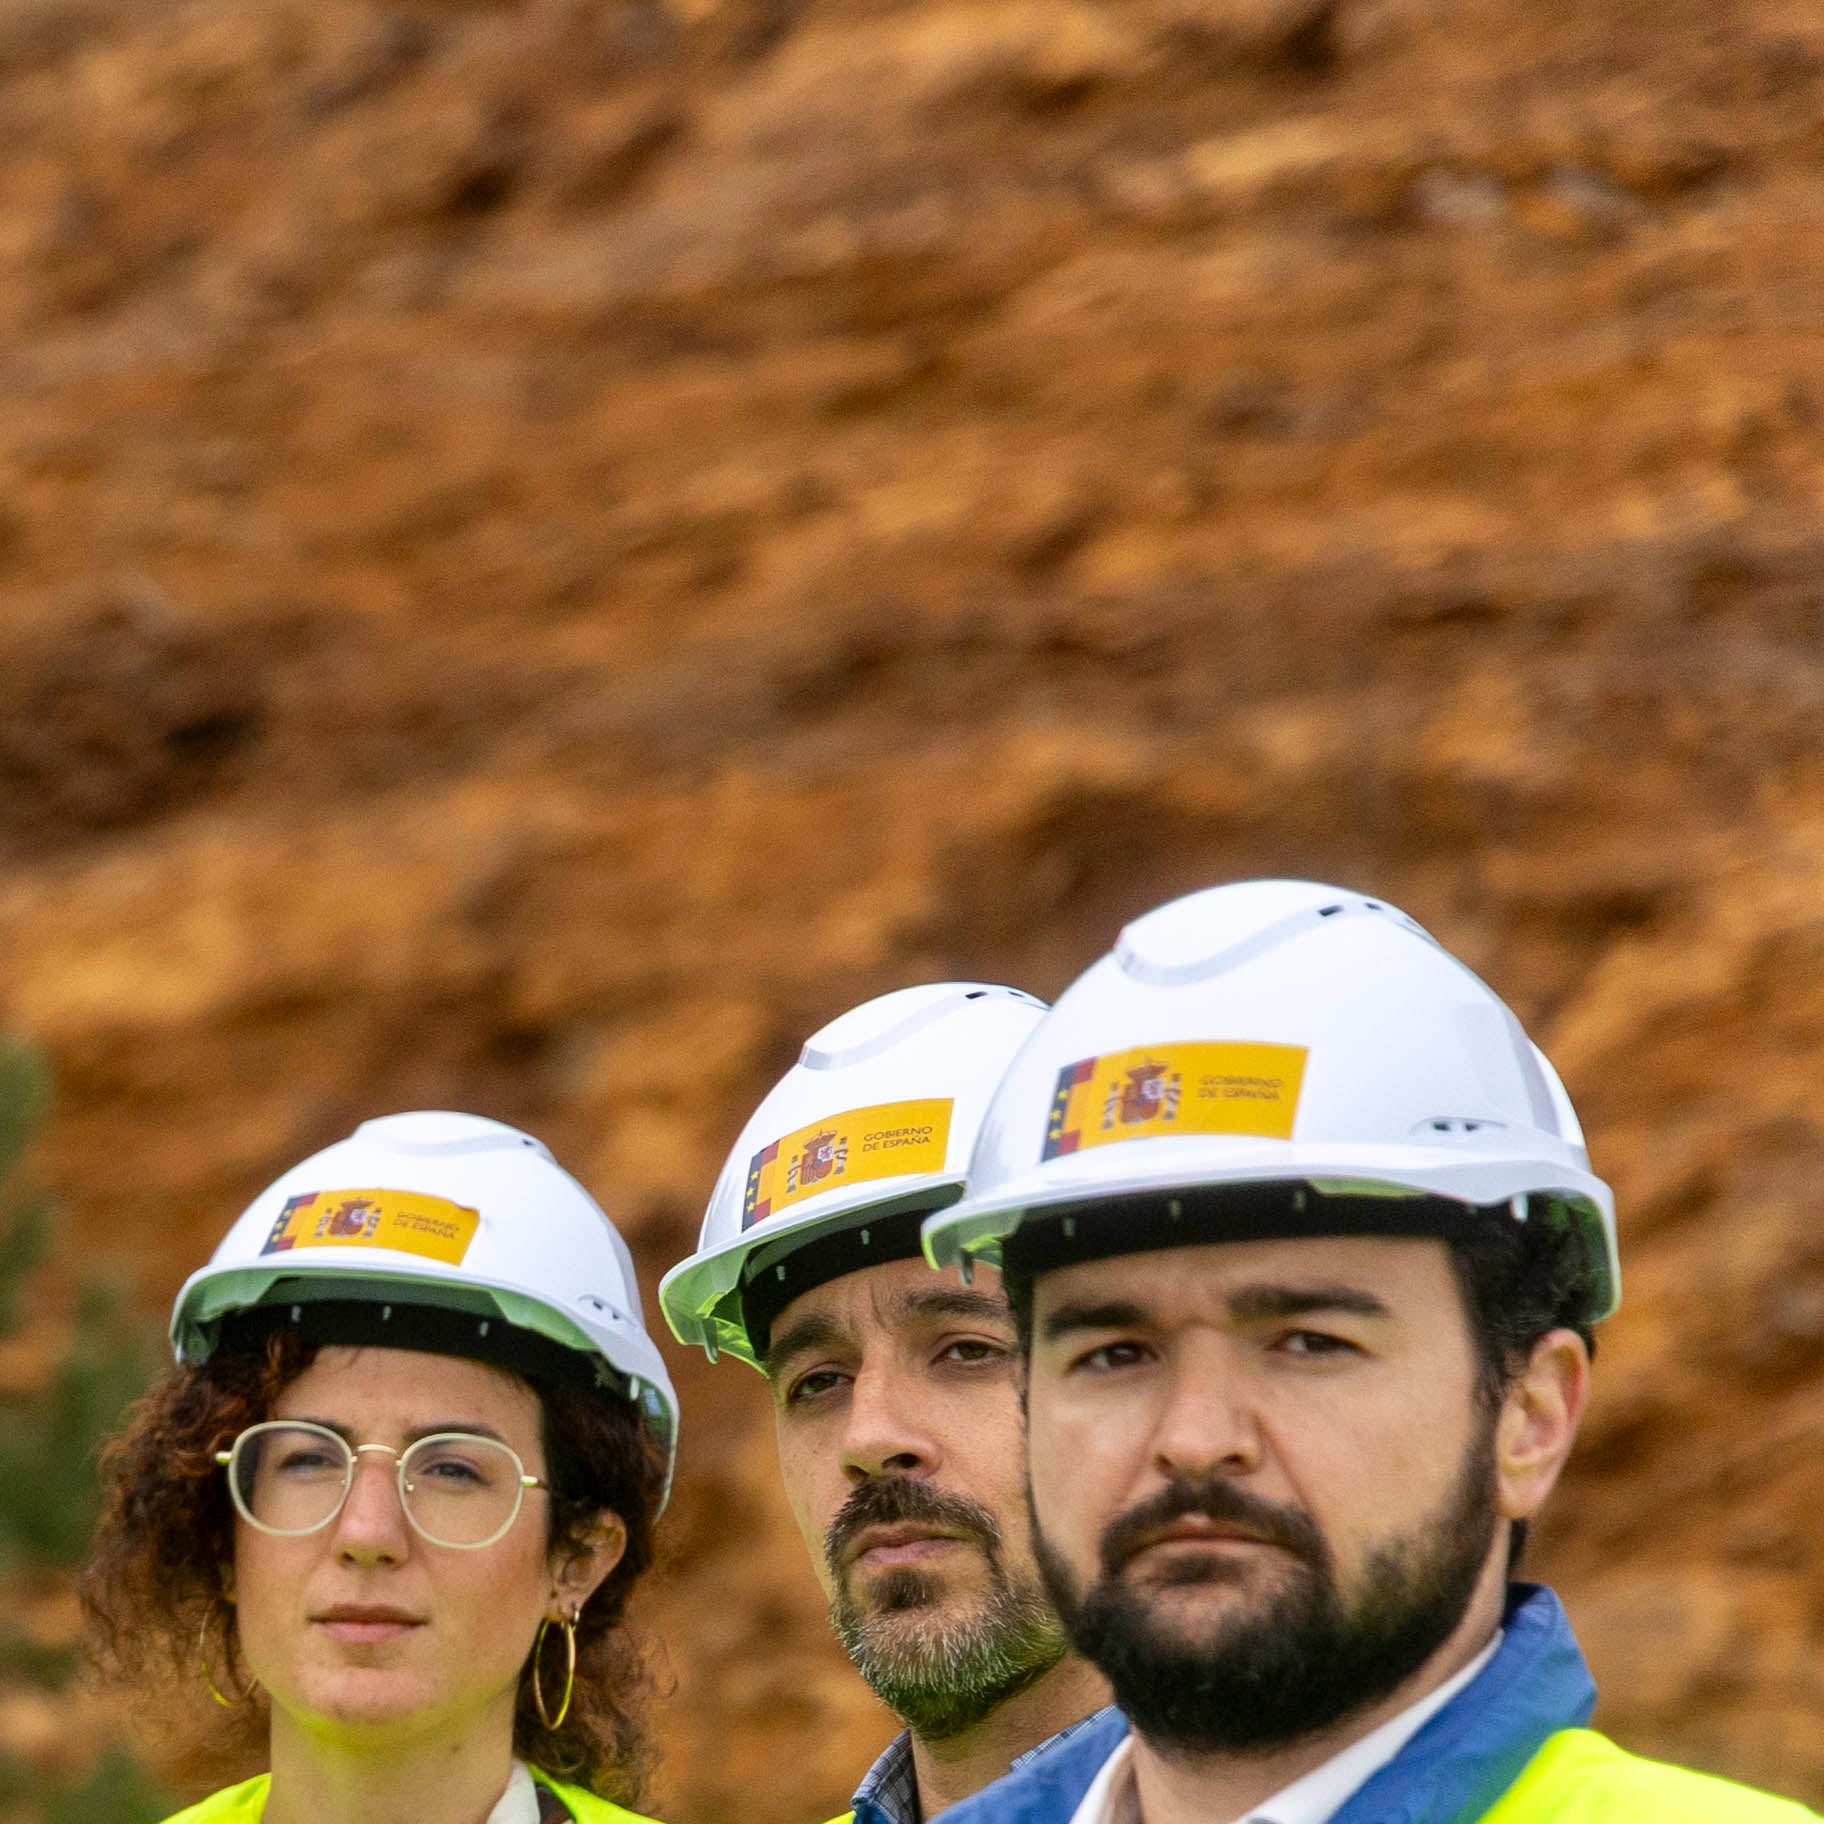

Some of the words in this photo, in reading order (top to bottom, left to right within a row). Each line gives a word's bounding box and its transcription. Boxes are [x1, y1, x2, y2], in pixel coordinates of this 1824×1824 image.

[863, 1125, 933, 1142] GOBIERNO
[862, 1142, 880, 1153] DE
[882, 1134, 931, 1150] ESPAÑA
